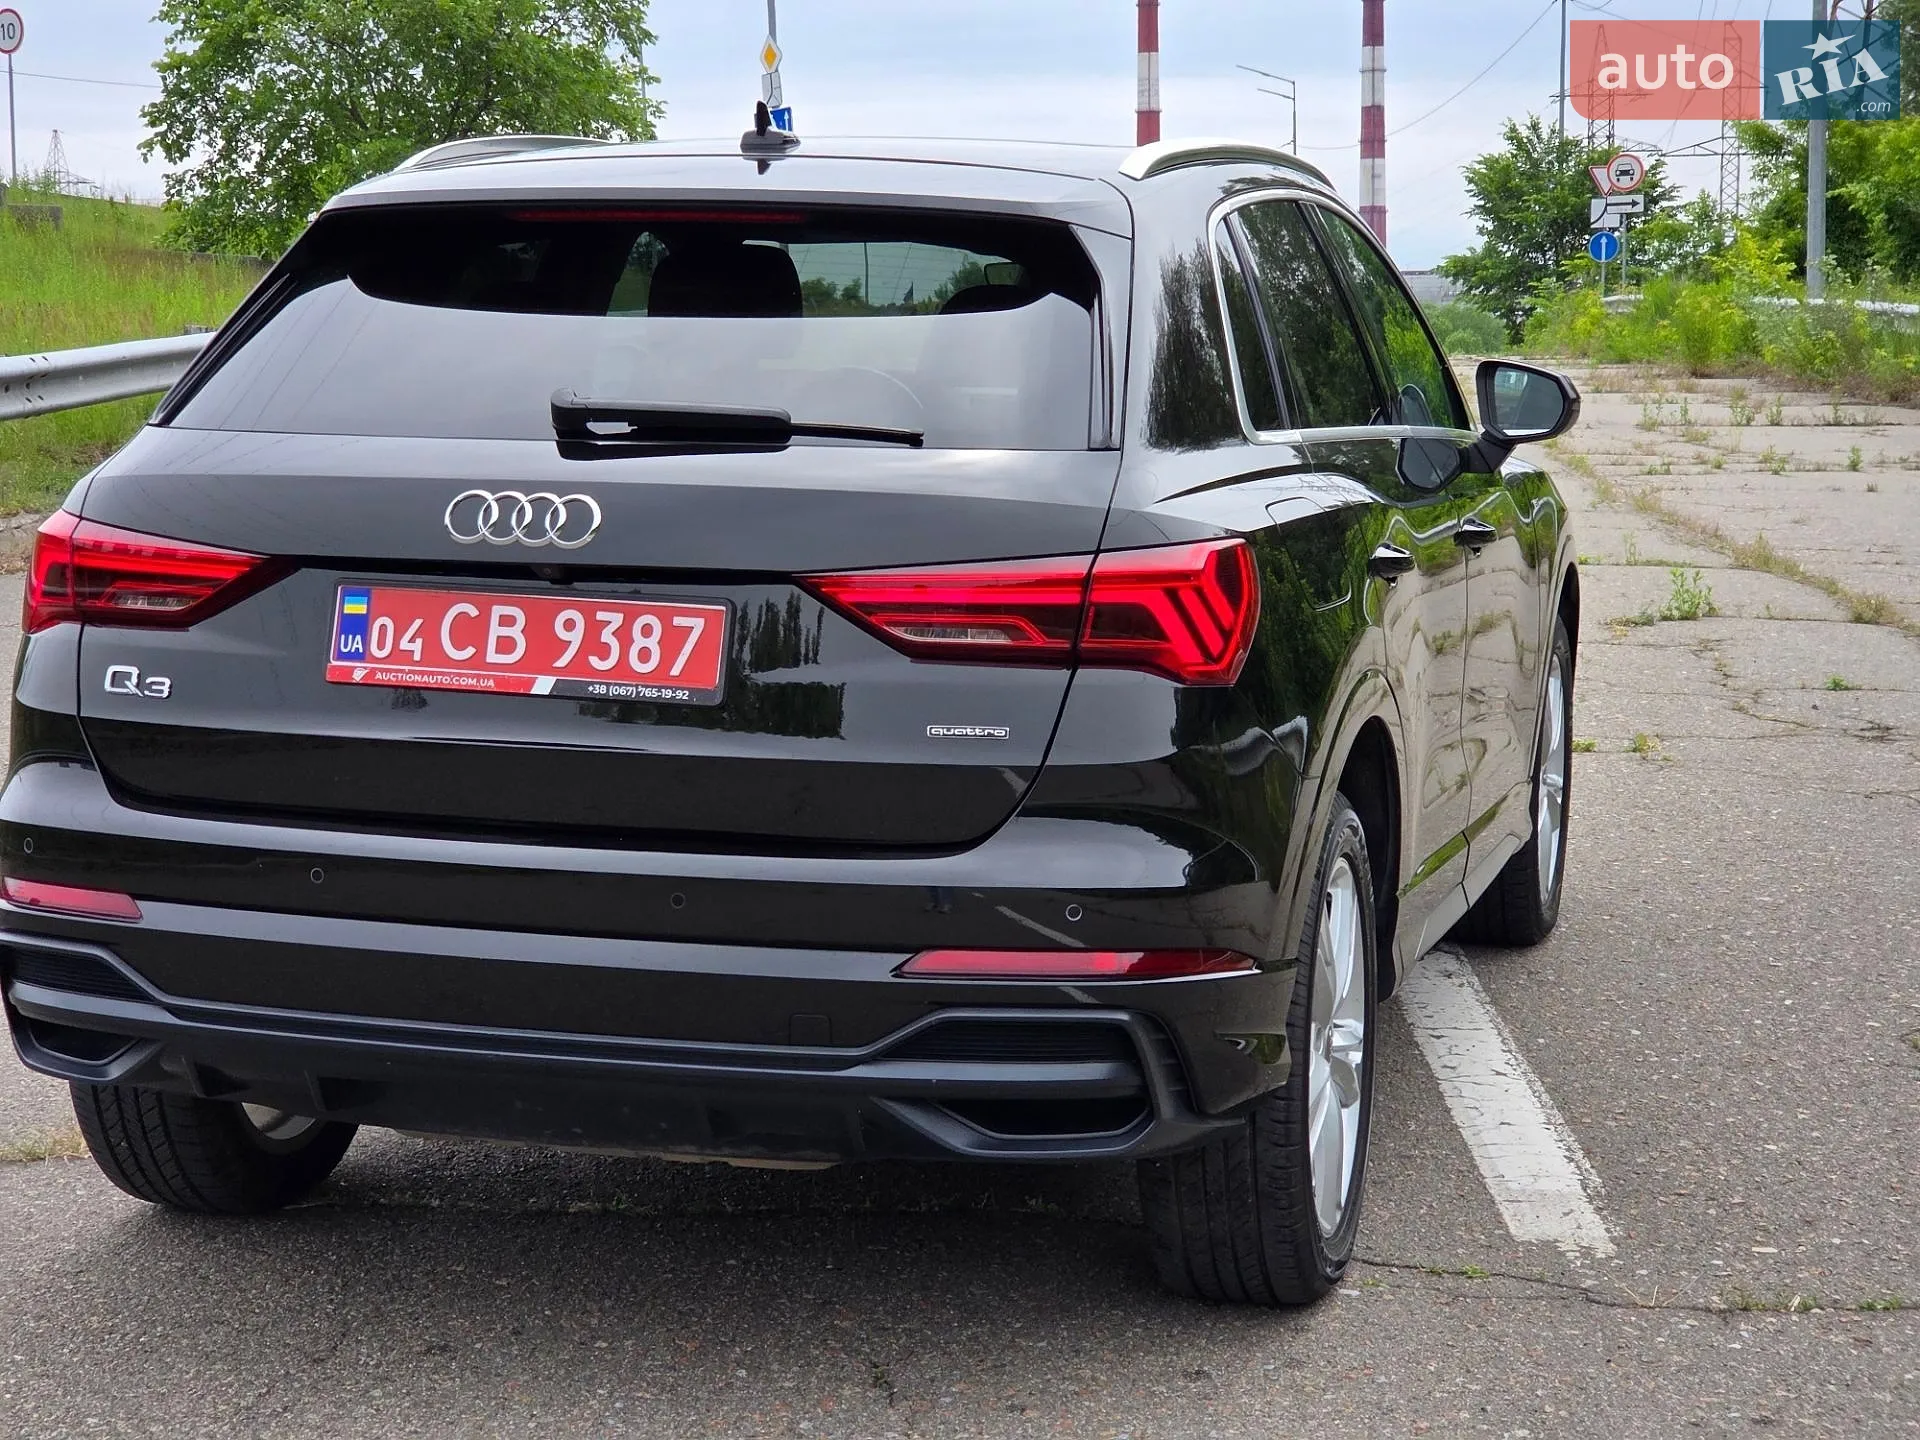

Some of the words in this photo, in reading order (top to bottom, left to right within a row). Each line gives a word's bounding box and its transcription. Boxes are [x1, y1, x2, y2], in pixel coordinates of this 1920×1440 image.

[1, 23, 15, 40] 10
[340, 634, 363, 653] UA
[370, 616, 424, 661] 04
[440, 602, 527, 664] CB
[552, 608, 705, 677] 9387
[104, 665, 171, 698] Q3
[375, 671, 495, 688] AUCTIONAUTO.COM.UA
[588, 684, 607, 695] +38
[609, 685, 637, 698] (067)
[638, 687, 689, 700] 765-19-92
[931, 728, 1006, 737] quattro
